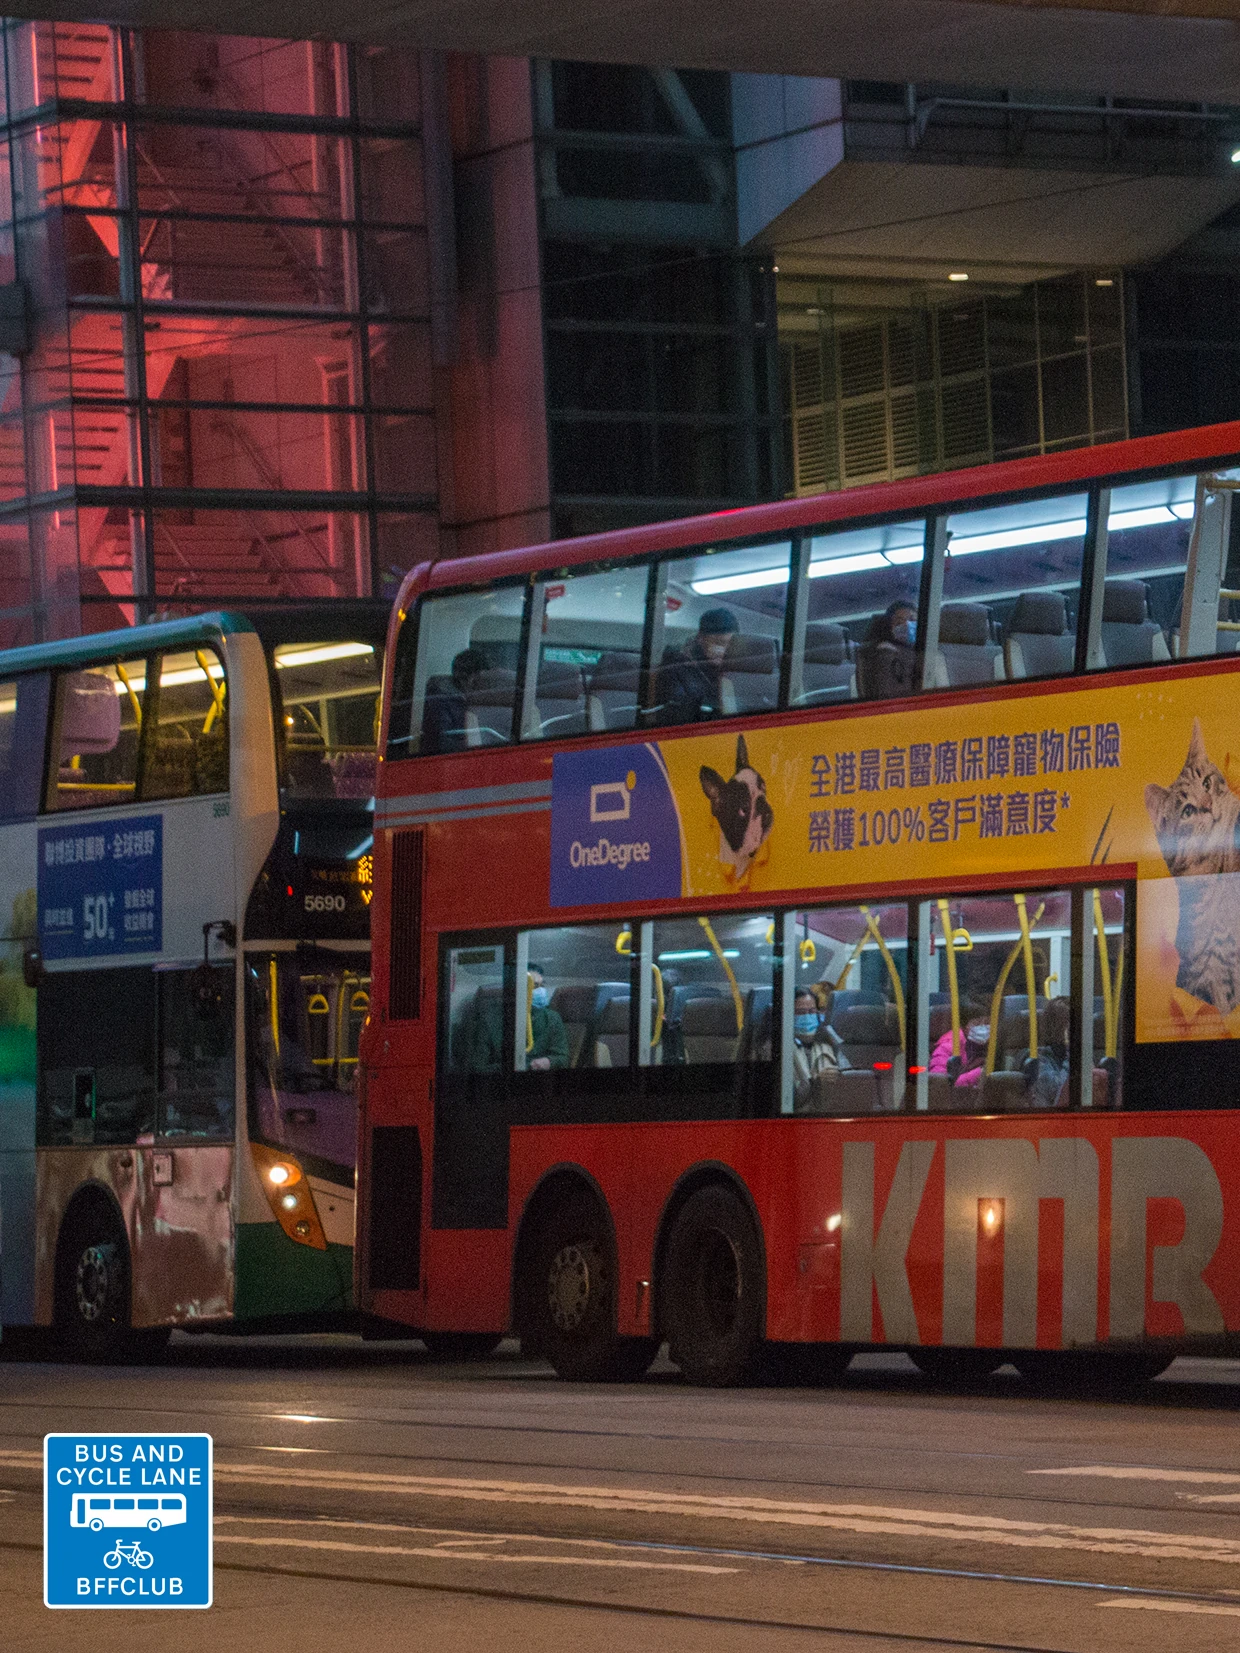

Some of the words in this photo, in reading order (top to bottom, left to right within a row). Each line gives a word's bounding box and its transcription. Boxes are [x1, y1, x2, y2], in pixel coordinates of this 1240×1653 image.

[811, 722, 1121, 798] 全港最高醫療保障寵物保險
[570, 839, 650, 870] OneDegree
[305, 896, 345, 912] 5690
[840, 1136, 1226, 1350] KMB
